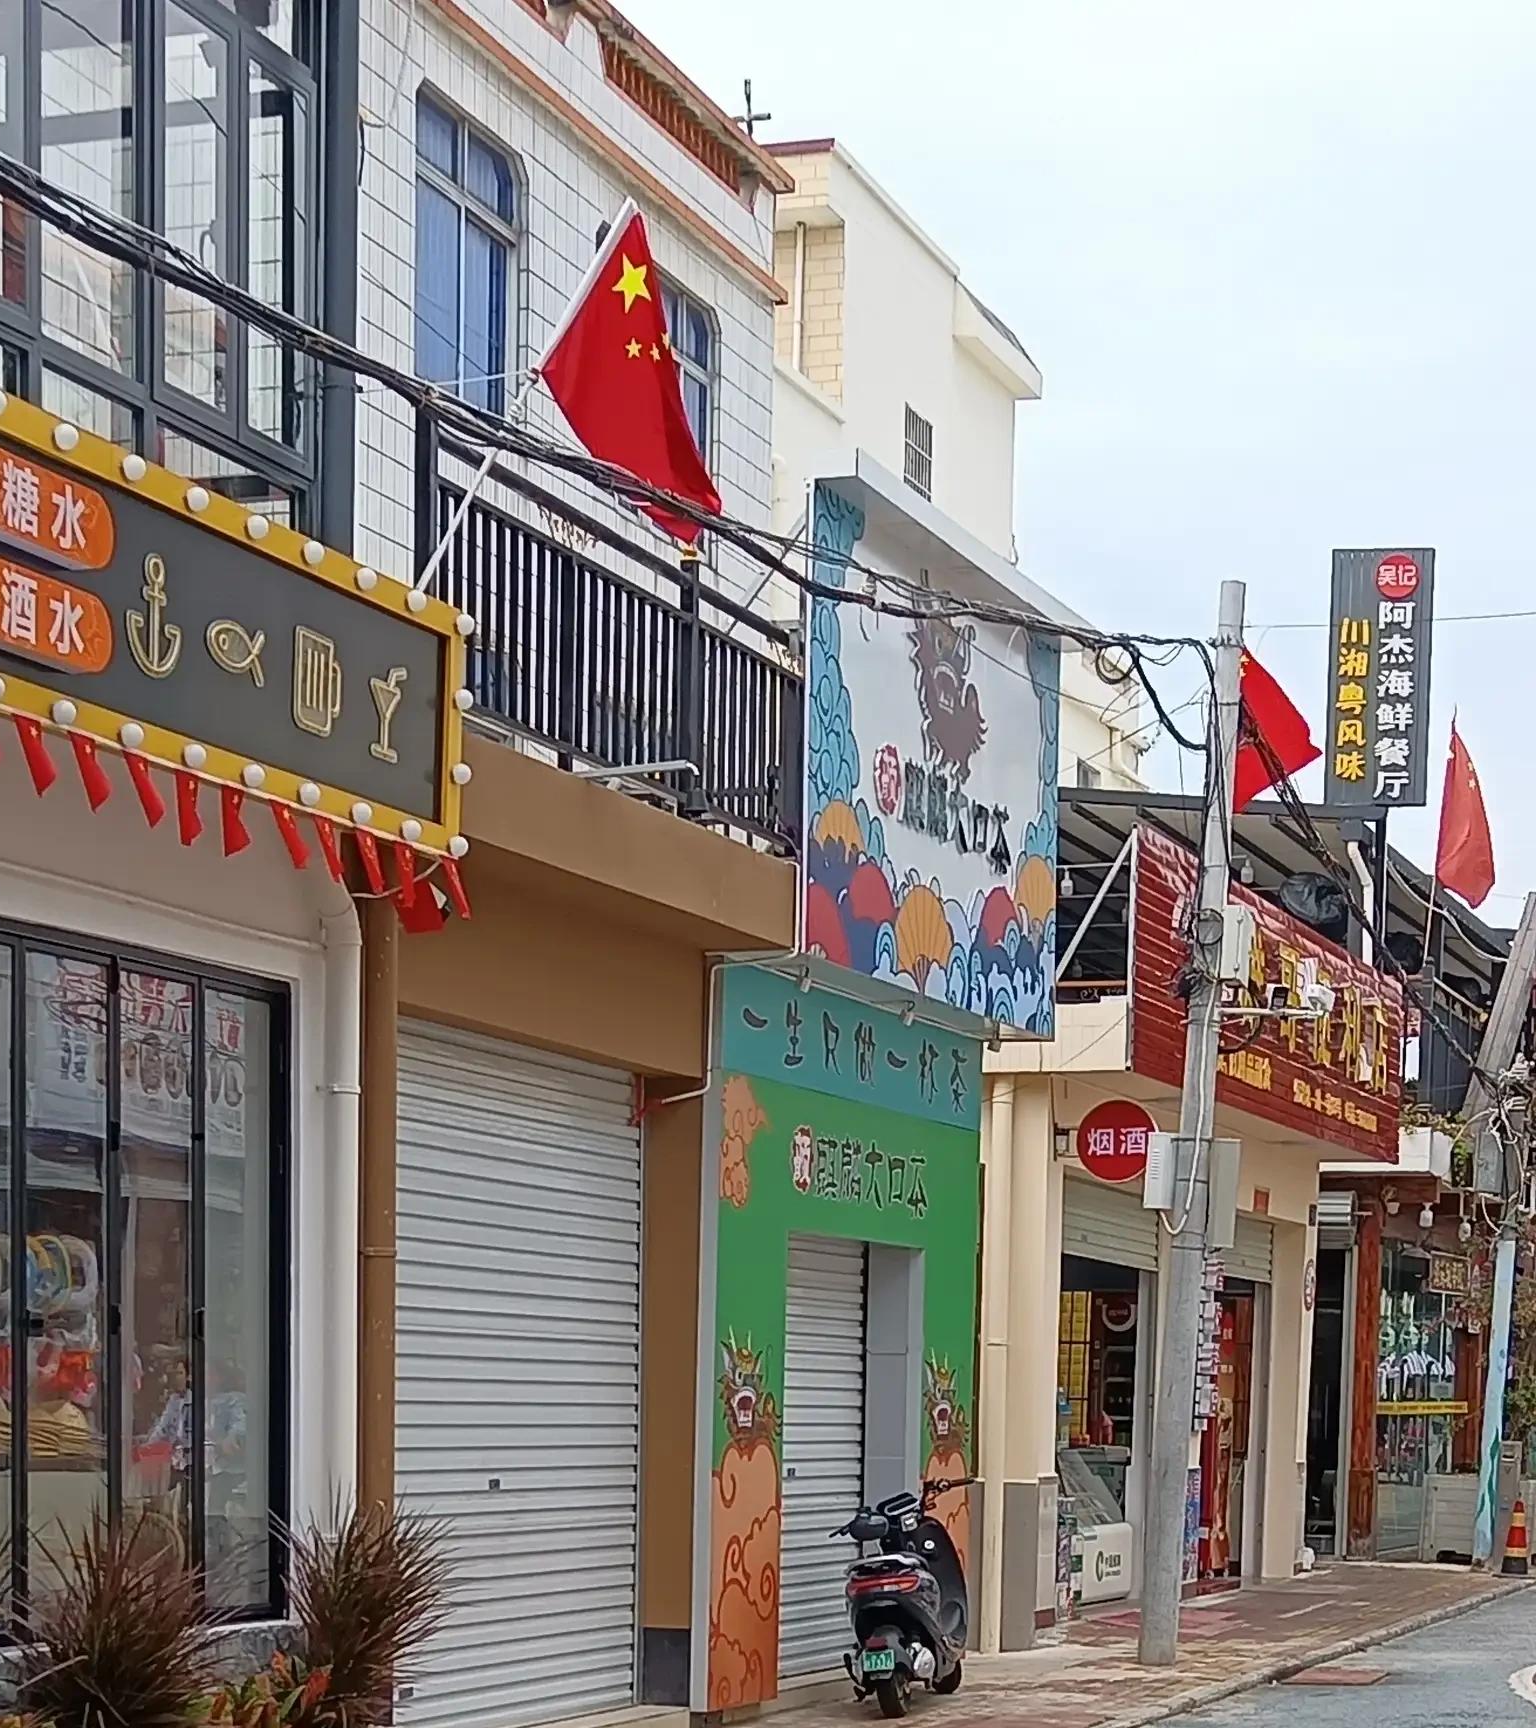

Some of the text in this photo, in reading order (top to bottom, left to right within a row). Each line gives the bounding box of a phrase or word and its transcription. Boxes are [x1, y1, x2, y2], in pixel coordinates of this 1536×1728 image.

[1, 458, 86, 550] 糖水
[1, 567, 85, 655] 酒水
[1378, 565, 1417, 587] 吴记
[1335, 617, 1369, 781] 川湘粤风味
[1373, 601, 1416, 799] 阿杰海鲜餐厅
[1087, 1127, 1148, 1157] 烟酒
